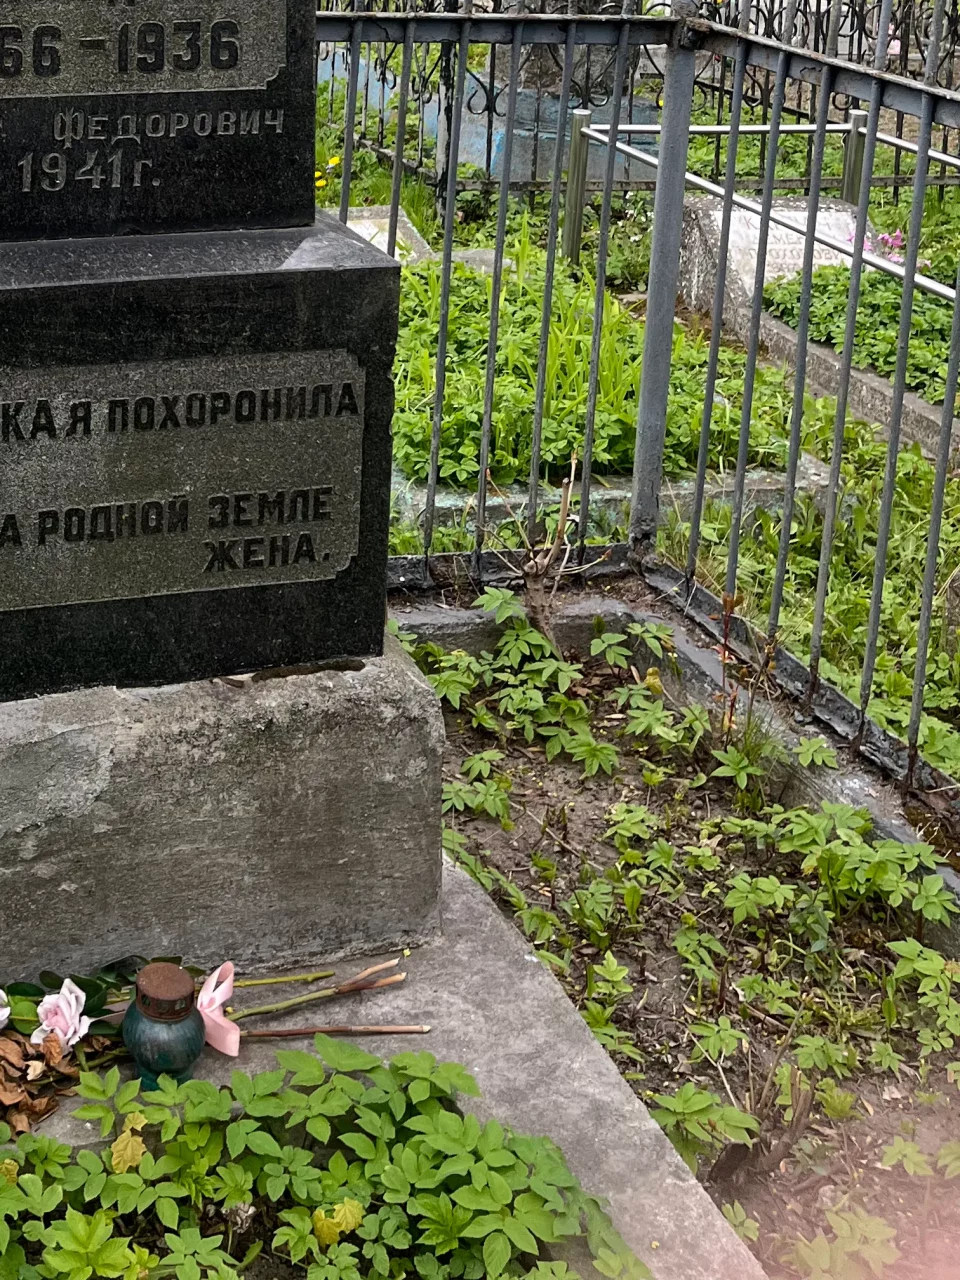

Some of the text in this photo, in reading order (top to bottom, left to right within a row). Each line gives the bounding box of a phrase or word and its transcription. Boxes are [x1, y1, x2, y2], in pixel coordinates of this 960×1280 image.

[107, 382, 360, 432] ПОХОРОНИЛА
[38, 493, 190, 546] РОДНОЙ
[206, 486, 335, 530] ЗЕМЛЕ
[201, 531, 331, 574] ЖЕНА.
